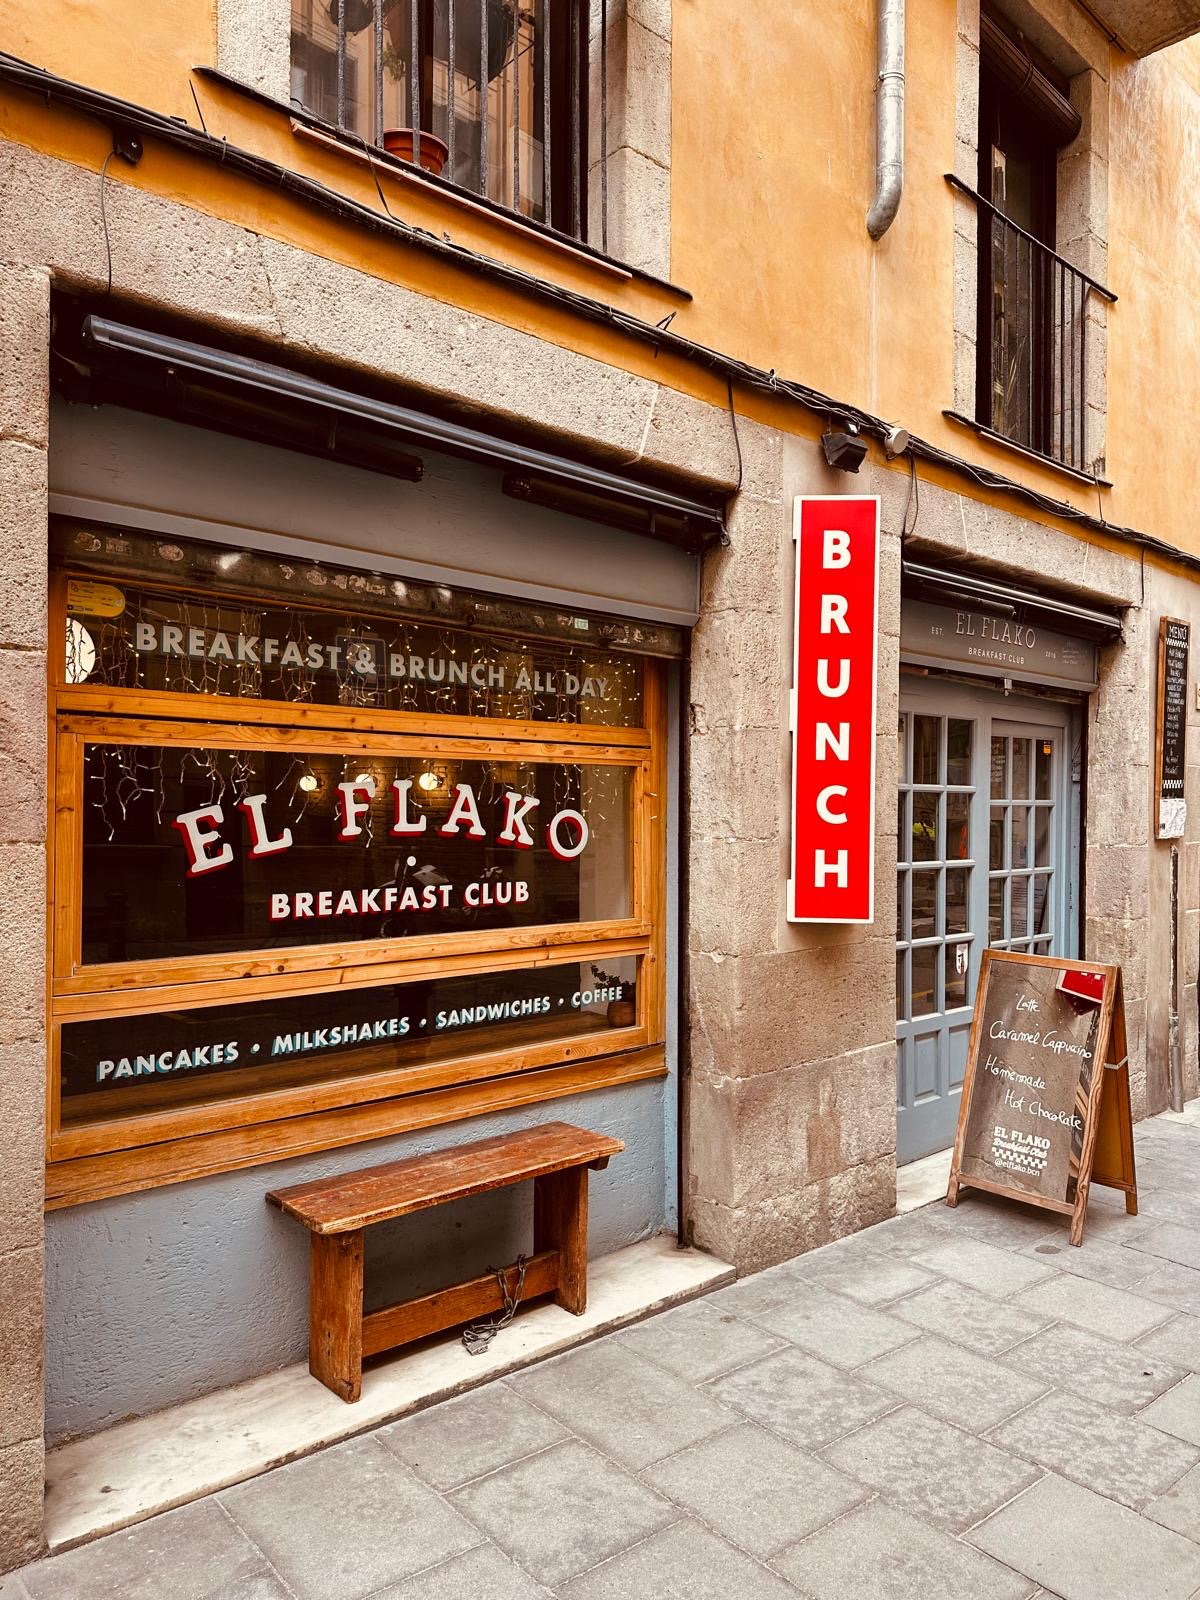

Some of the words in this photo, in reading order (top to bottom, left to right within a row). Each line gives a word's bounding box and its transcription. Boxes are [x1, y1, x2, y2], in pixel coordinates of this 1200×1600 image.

[930, 627, 944, 637] EST.
[956, 612, 975, 636] EL
[980, 616, 1036, 649] FLAKO
[136, 623, 342, 672] BREAKFAST
[352, 649, 377, 676] &
[389, 654, 505, 688] BRUNCH
[515, 668, 558, 693] ALL
[566, 674, 609, 700] DAY
[968, 647, 1006, 662] BREAKFAST
[1008, 653, 1025, 665] CLUB
[813, 529, 852, 889] BRUNCH
[173, 793, 294, 878] EL
[337, 778, 590, 862] FLAKO
[269, 885, 452, 922] BREAKFAST
[464, 880, 530, 908] CLUB
[1016, 994, 1040, 1013] Latte
[96, 1041, 239, 1083] PANCAKES
[271, 1016, 411, 1056] MILKSHAKES
[435, 996, 551, 1029] SANDWICHES
[571, 986, 623, 1008] COFFEE
[989, 1020, 1040, 1046] Caramel
[1042, 1030, 1092, 1059] Cappuccino
[985, 1055, 1046, 1089] Homemade
[1005, 1089, 1026, 1112] Hot
[1029, 1102, 1083, 1131] Chocolate
[994, 1126, 1008, 1138] EL
[1011, 1131, 1051, 1149] FLAKO
[994, 1158, 1041, 1177] @elflako.bcn
